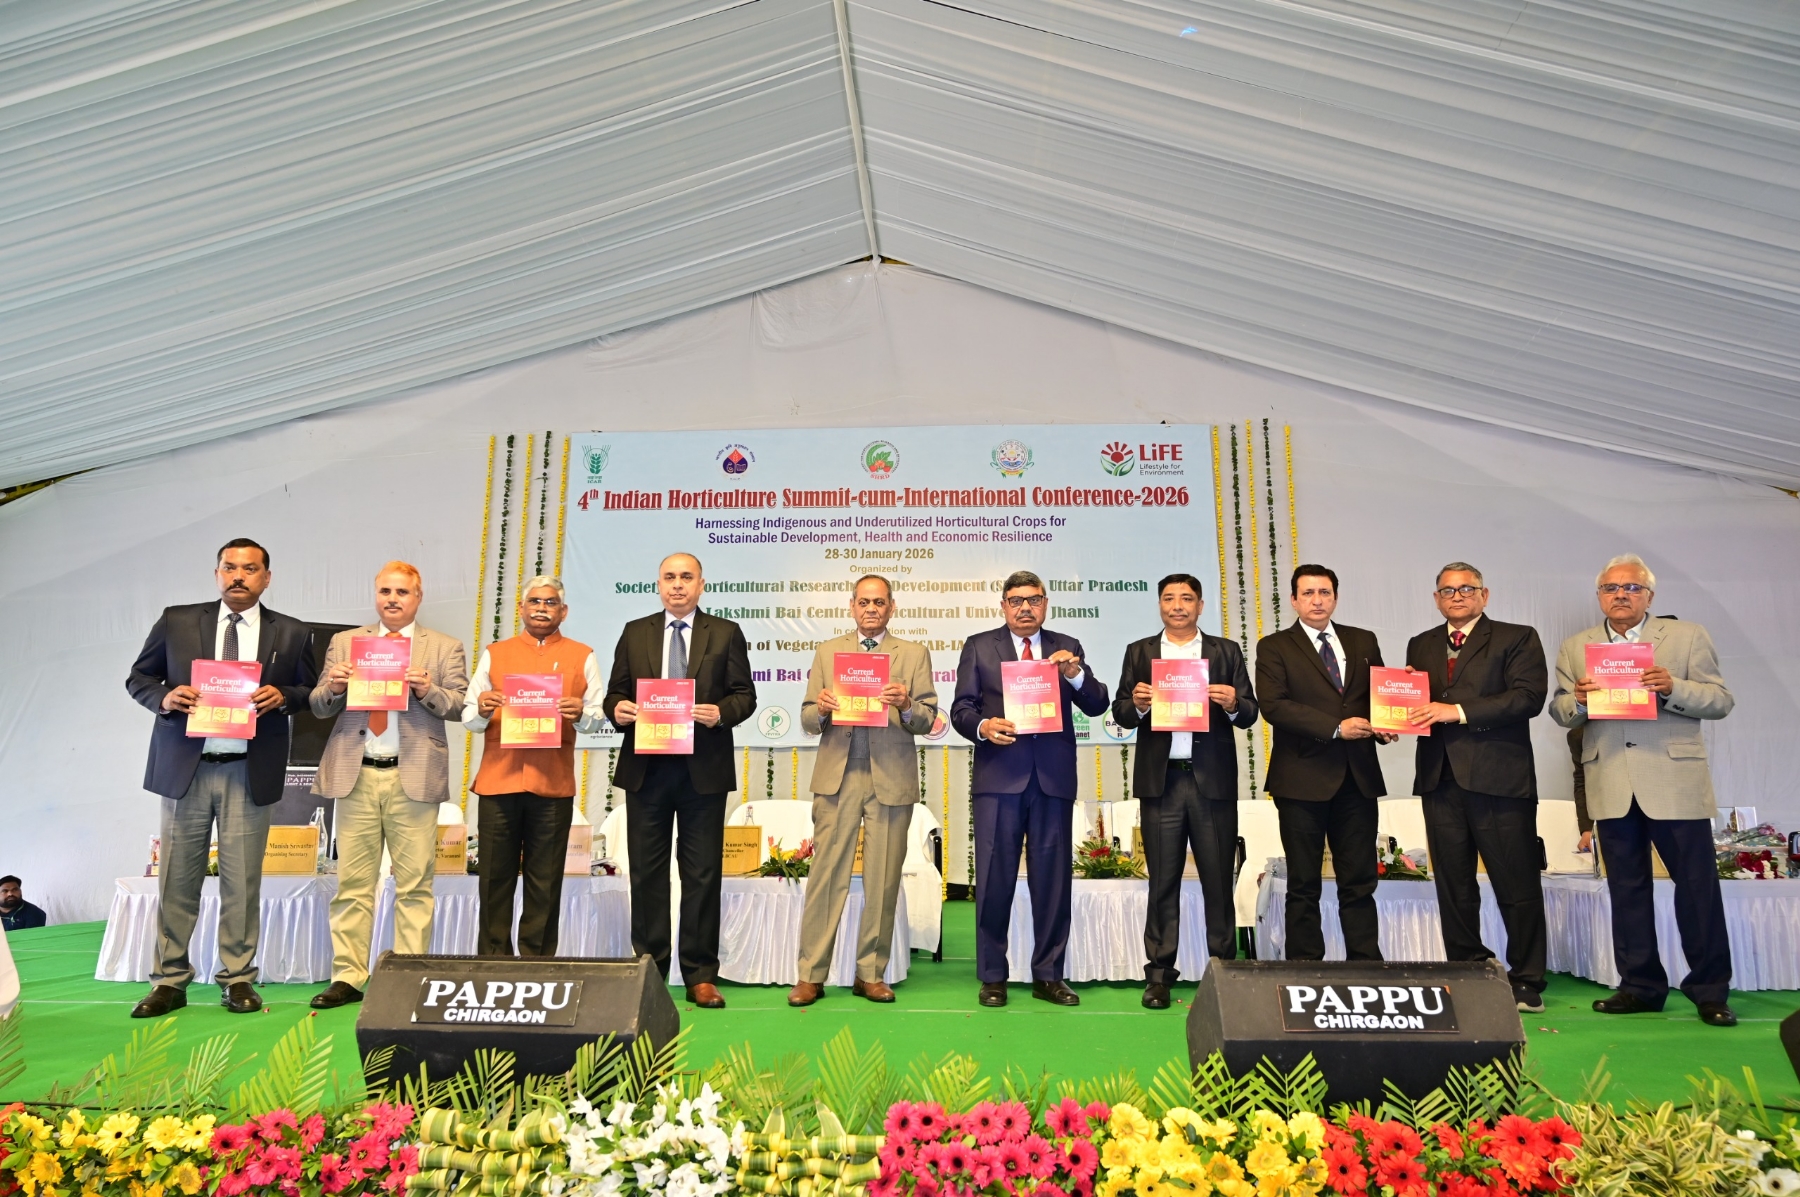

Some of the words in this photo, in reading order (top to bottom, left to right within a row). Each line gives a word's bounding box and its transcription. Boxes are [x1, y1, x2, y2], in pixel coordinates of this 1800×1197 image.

[1139, 443, 1183, 461] LiFE
[1139, 463, 1169, 471] Lifestyle
[577, 488, 599, 511] 4th
[603, 490, 662, 511] Indian
[667, 488, 777, 510] Horticulture
[782, 486, 1026, 508] Summit-cum-International
[1032, 486, 1190, 508] Conference-2026
[695, 517, 760, 530] Harnessing
[763, 517, 827, 530] Indigenous
[829, 516, 852, 527] and
[855, 516, 932, 527] Underutilized
[935, 515, 1009, 527] Horticultural
[1012, 515, 1047, 529] Crops
[1049, 515, 1067, 527] for
[708, 532, 778, 543] Sustainable
[781, 531, 861, 545] Development,
[864, 531, 902, 542] Health
[905, 531, 928, 542] and
[931, 531, 989, 542] Economic
[992, 530, 1053, 542] Resilience
[824, 548, 858, 559] 28-30
[859, 548, 902, 561] January
[904, 548, 934, 559] 2026
[849, 565, 898, 574] Organized
[900, 565, 913, 574] by
[703, 580, 784, 593] orticultural
[789, 580, 853, 593] Research
[891, 579, 987, 593] Development
[1049, 579, 1084, 592] Uttar
[1088, 579, 1148, 592] Pradesh
[775, 606, 801, 619] Bai
[806, 606, 852, 618] Centra
[892, 606, 960, 618] icultural
[1050, 606, 1100, 620] Jhansi
[833, 627, 843, 635] In
[908, 627, 928, 635] with
[756, 639, 771, 651] of
[365, 651, 395, 659] Current
[356, 658, 402, 667] Horticulture
[1602, 658, 1635, 667] Current
[847, 667, 874, 676] Current
[1594, 666, 1645, 674] Horticulture
[776, 668, 802, 682] Bai
[840, 674, 882, 683] Horticulture
[1016, 675, 1043, 683] Current
[1165, 673, 1193, 681] Current
[210, 676, 242, 686] Current
[1158, 680, 1200, 688] Horticulture
[1385, 680, 1413, 688] Current
[1009, 682, 1052, 691] Horticulture
[1377, 685, 1422, 695] Horticulture
[517, 689, 546, 697] Current
[509, 696, 554, 704] Horticulture
[650, 694, 678, 702] Current
[643, 701, 686, 709] Horticulture
[423, 980, 574, 1010] PAPPU
[1285, 985, 1444, 1015] PAPPU
[443, 1008, 547, 1024] CHIRGAON
[1313, 1014, 1425, 1029] CHIRGAON
